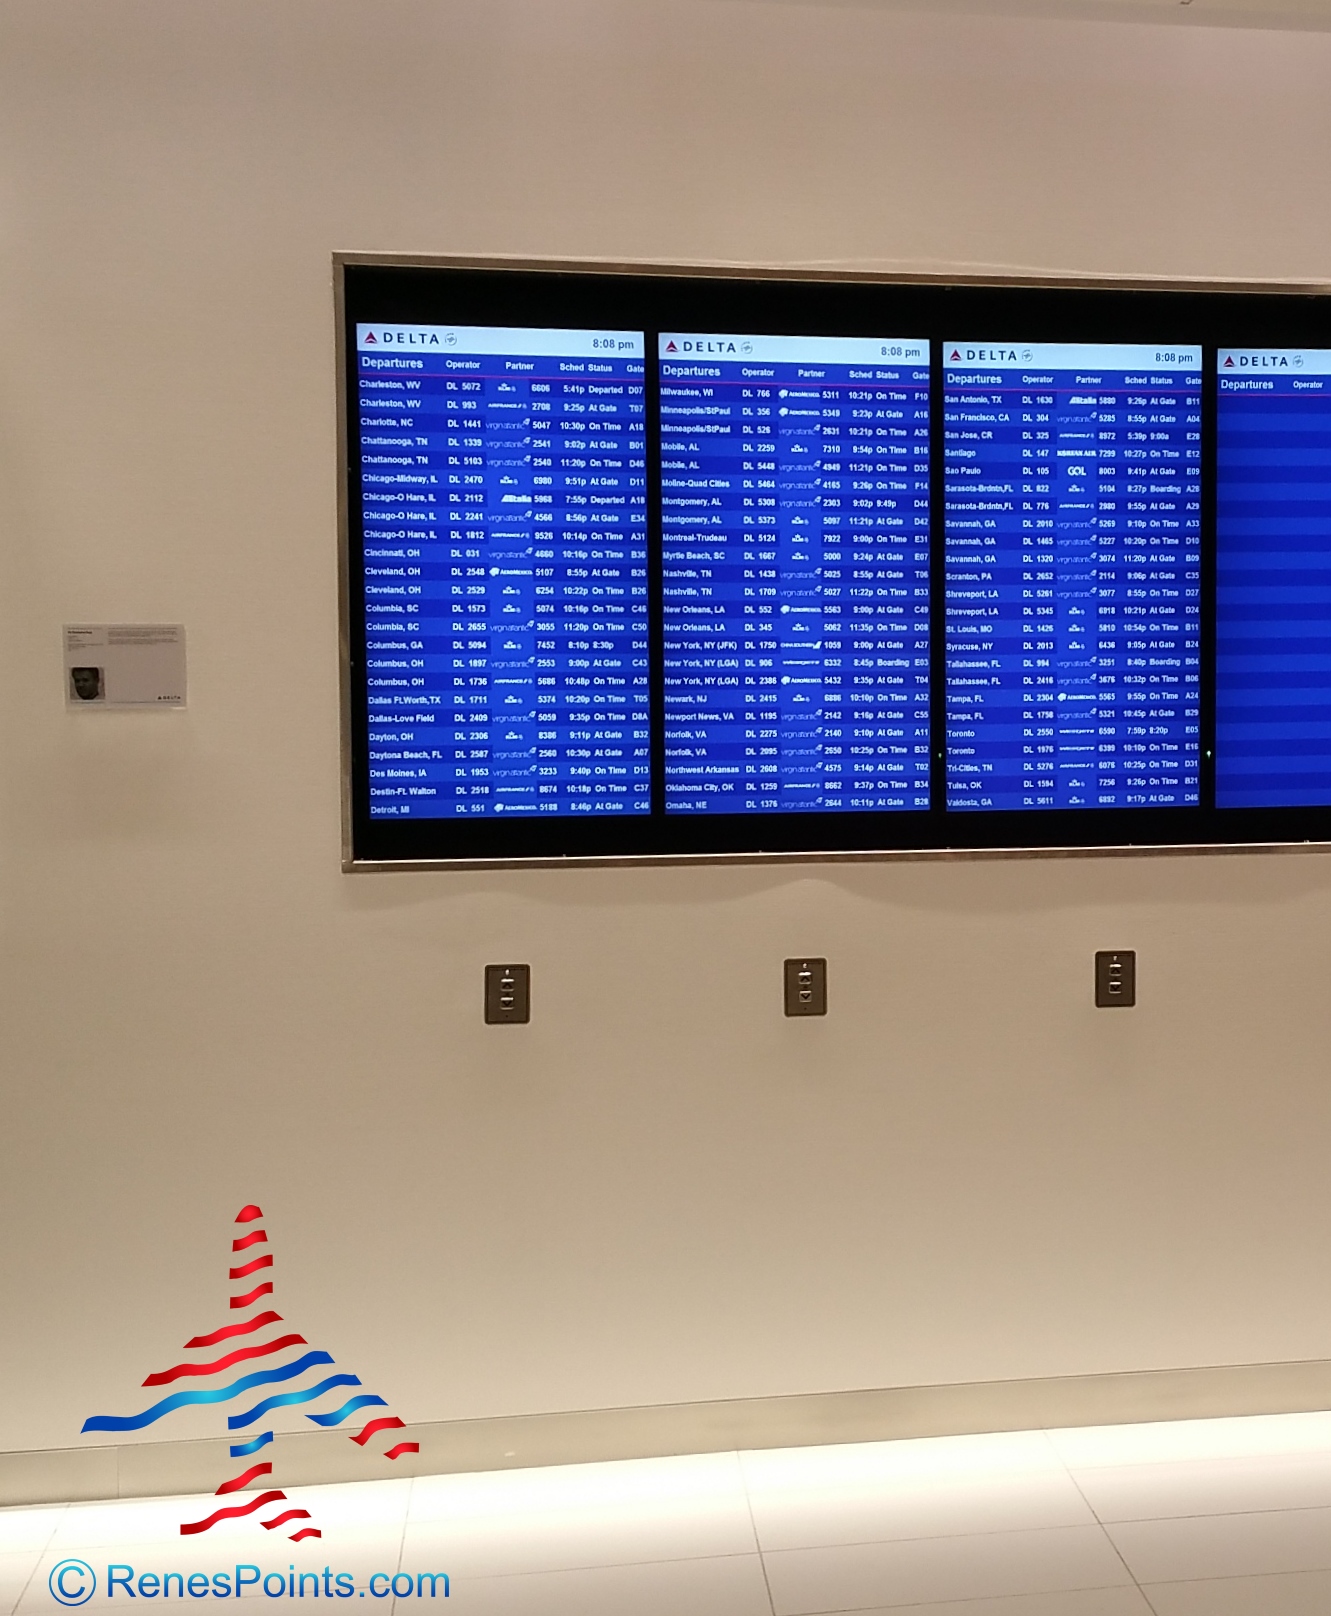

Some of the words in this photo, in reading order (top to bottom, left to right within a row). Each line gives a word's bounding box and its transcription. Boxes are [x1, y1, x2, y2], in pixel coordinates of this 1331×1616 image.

[383, 332, 439, 344] DELTA
[593, 338, 615, 349] 8:08
[618, 342, 634, 351] pm
[683, 341, 736, 353] DELTA
[881, 346, 902, 356] 8:08
[905, 349, 920, 358] pm
[967, 350, 1017, 361] DELTA
[1155, 352, 1176, 362] 8:08
[1178, 355, 1193, 364] pm
[362, 356, 423, 370] Departures
[445, 360, 481, 370] Operator
[505, 362, 534, 370] Partner
[560, 363, 584, 371] Sched
[588, 364, 613, 372] Status
[626, 364, 644, 373] Gate
[1240, 356, 1288, 366] DELTA
[663, 365, 721, 377] Departures
[742, 368, 775, 377] Operator
[798, 369, 825, 377] Partner
[849, 370, 873, 379] Sched
[876, 371, 899, 379] Status
[912, 371, 930, 380] Gate
[947, 373, 1002, 385] Departures
[1022, 375, 1054, 384] Operator
[1076, 376, 1102, 384] Partner
[1125, 376, 1147, 384] Sched
[1150, 376, 1173, 384] Status
[1185, 377, 1202, 385] Gate
[1221, 379, 1274, 391] Departures
[1293, 380, 1323, 390] Operator
[359, 380, 405, 390] Charleston,
[406, 381, 421, 390] WV
[446, 382, 459, 391] DL
[462, 382, 481, 391] 5072
[563, 385, 585, 395] 5:41p
[588, 385, 623, 396] Departed
[628, 386, 643, 395] D07
[660, 388, 702, 397] Milwaukee,
[703, 388, 714, 397] WI
[742, 389, 753, 398] DL
[757, 389, 771, 398] 766
[822, 390, 839, 399] 5311
[848, 391, 873, 401] 10:21p
[876, 392, 887, 400] On
[889, 392, 907, 400] Time
[360, 417, 399, 427] Charlotte,
[400, 418, 414, 427] NC
[447, 419, 459, 428] DL
[463, 420, 481, 428] 1441
[533, 421, 551, 430] 5047
[560, 422, 586, 432] 10:30p
[589, 422, 601, 431] On
[602, 422, 622, 431] Time
[944, 413, 959, 421] San
[960, 413, 997, 423] Francisco,
[998, 413, 1010, 422] CA
[1022, 414, 1033, 422] DL
[1036, 414, 1049, 422] 304
[1127, 414, 1147, 424] 8:55p
[1150, 415, 1158, 423] At
[1159, 415, 1176, 423] Gate
[1186, 415, 1200, 423] A04
[661, 442, 687, 452] Mobile,
[688, 443, 700, 451] AL
[743, 443, 754, 452] DL
[757, 444, 775, 452] 2259
[853, 445, 873, 455] 9:54p
[876, 446, 888, 454] On
[889, 446, 907, 454] Time
[945, 467, 960, 475] Sao
[960, 467, 981, 475] Paulo
[1022, 467, 1033, 475] DL
[1036, 467, 1050, 475] 105
[1067, 466, 1086, 476] GOL
[1127, 467, 1147, 477] 9:41p
[365, 567, 406, 576] Cleveland,
[407, 567, 421, 576] OH
[451, 568, 463, 576] DL
[466, 568, 485, 576] 2548
[535, 568, 554, 577] 5107
[567, 568, 588, 578] 8:55p
[591, 569, 601, 577] At
[602, 568, 620, 577] Gate
[663, 588, 699, 597] Nashville,
[701, 588, 712, 596] TN
[744, 588, 755, 596] DL
[759, 588, 777, 596] 1709
[824, 588, 841, 596] 5027
[850, 588, 874, 597] 11:22p
[877, 588, 888, 596] On
[889, 588, 907, 596] Time
[366, 623, 406, 632] Columbia,
[407, 622, 420, 631] SC
[452, 623, 464, 631] DL
[468, 623, 486, 631] 2655
[537, 623, 555, 631] 3055
[564, 623, 589, 632] 11:20p
[592, 623, 605, 631] On
[606, 623, 625, 631] Time
[683, 642, 703, 650] York,
[716, 641, 738, 651] (JFK)
[745, 641, 756, 649] DL
[759, 641, 777, 649] 1750
[877, 641, 885, 649] At
[887, 641, 904, 649] Gate
[914, 641, 929, 649] A27
[946, 695, 973, 704] Tampa,
[974, 695, 984, 703] FL
[1023, 694, 1034, 702] DL
[1037, 694, 1054, 702] 2304
[1127, 692, 1147, 702] 9:55p
[1149, 692, 1160, 700] On
[1161, 692, 1179, 700] Time
[665, 731, 694, 740] Norfolk,
[745, 730, 757, 738] DL
[760, 730, 778, 738] 2275
[824, 729, 842, 737] 2140
[877, 729, 886, 737] At
[947, 730, 975, 738] Toronto
[370, 770, 386, 778] Des
[387, 769, 417, 778] Moines,
[418, 769, 427, 777] IA
[455, 768, 467, 777] DL
[471, 768, 489, 776] 1953
[539, 767, 558, 776] 3233
[570, 767, 591, 776] 9:40p
[595, 767, 607, 775] On
[608, 766, 627, 774] Time
[634, 766, 649, 774] D13
